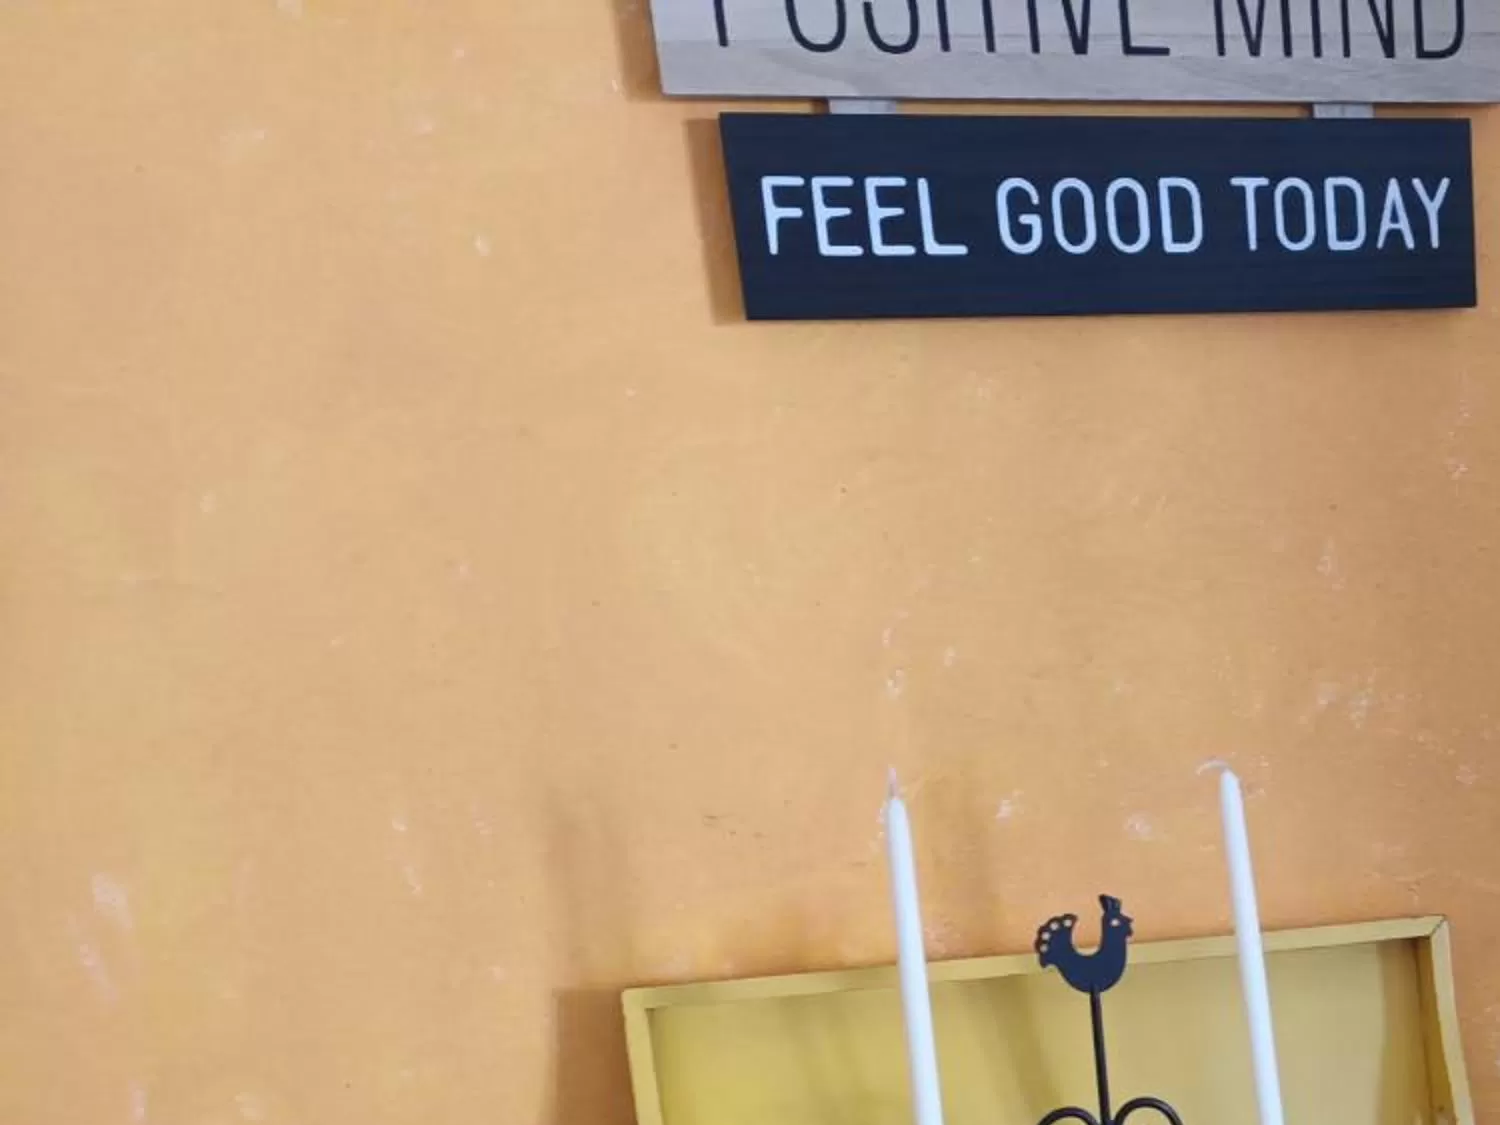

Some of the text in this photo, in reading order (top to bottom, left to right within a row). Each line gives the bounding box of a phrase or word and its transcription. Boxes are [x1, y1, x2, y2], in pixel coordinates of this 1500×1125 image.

[761, 175, 1451, 256] FEEL GOOD TODAY
